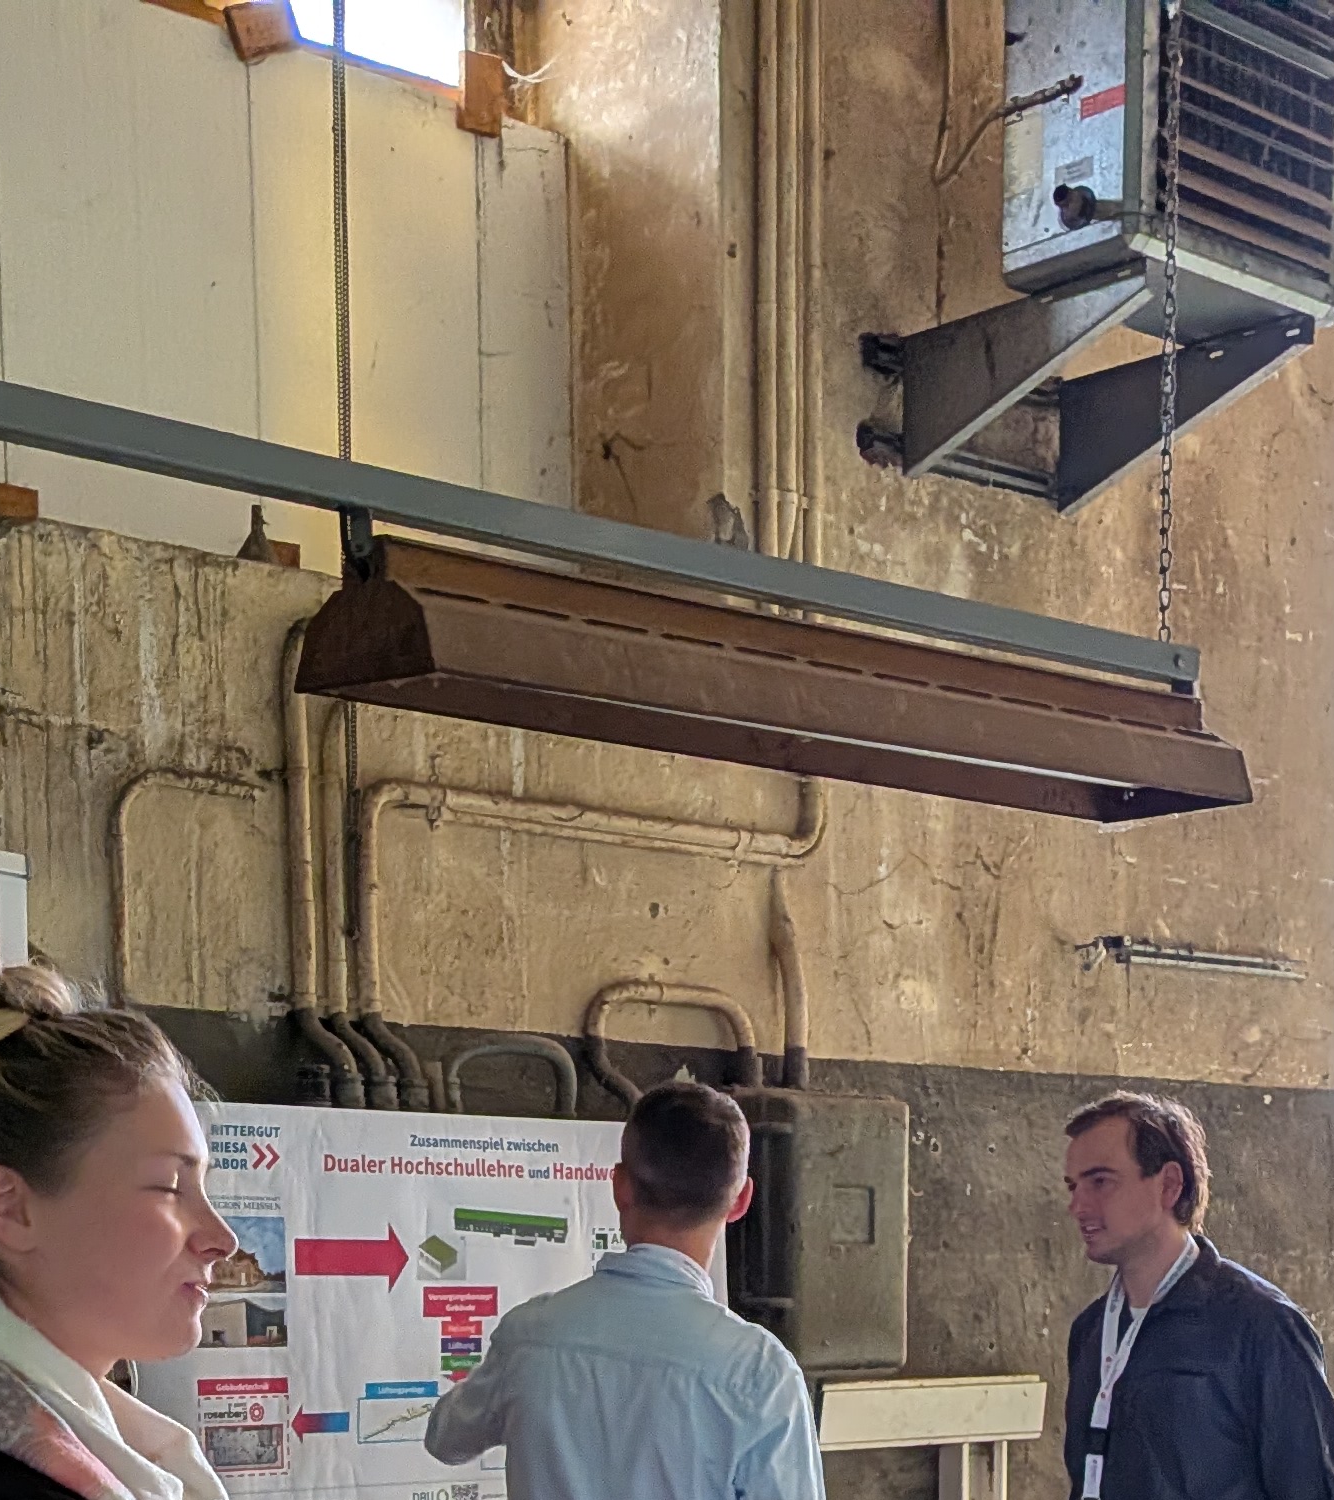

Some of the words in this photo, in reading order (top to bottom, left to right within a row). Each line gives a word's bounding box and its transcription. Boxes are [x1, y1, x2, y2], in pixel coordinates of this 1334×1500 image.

[210, 1124, 281, 1138] RITTERGUT
[211, 1141, 247, 1153] RIESA
[410, 1134, 504, 1152] Zusammenspiel
[507, 1140, 559, 1153] zwischen
[213, 1158, 248, 1170] ABOR
[323, 1154, 386, 1174] Dualer
[391, 1156, 524, 1178] Hochschullehre
[529, 1167, 550, 1180] und
[553, 1162, 616, 1181] Handwo
